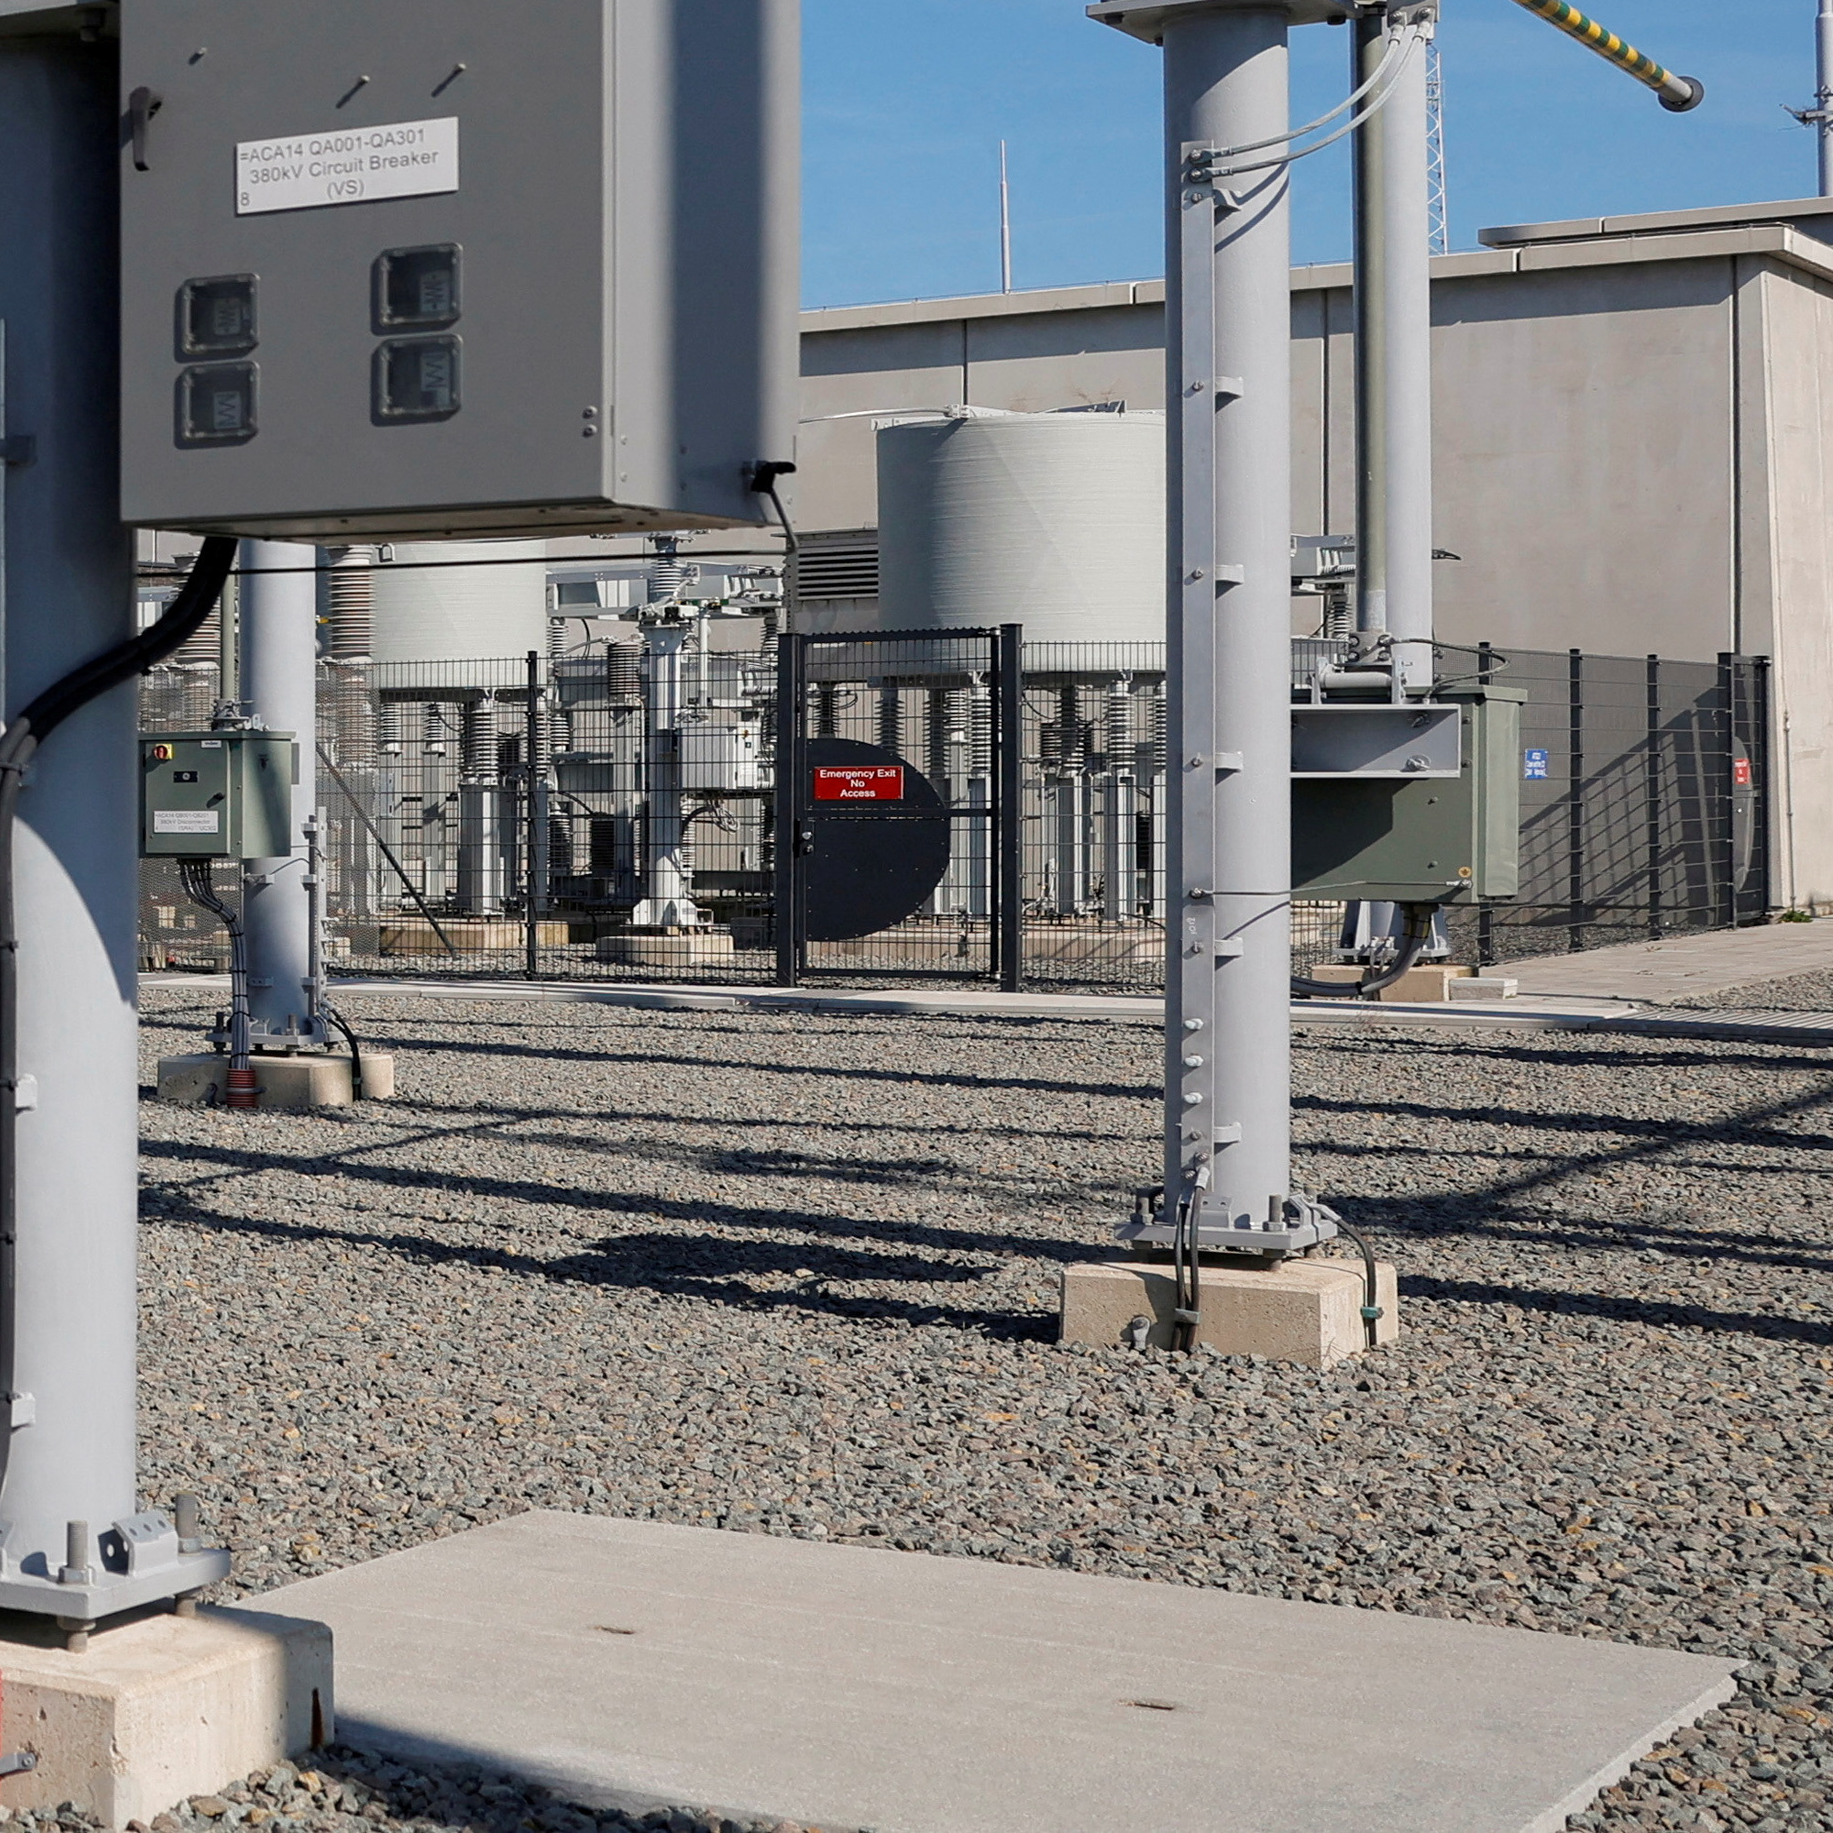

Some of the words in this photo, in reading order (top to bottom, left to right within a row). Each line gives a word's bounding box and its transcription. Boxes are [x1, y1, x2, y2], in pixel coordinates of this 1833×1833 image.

[240, 143, 303, 163] =ACA14
[309, 128, 424, 154] QA001-QA301
[250, 164, 304, 184] 380kV
[309, 158, 364, 177] Circuit
[370, 151, 438, 170] Breaker
[327, 179, 364, 199] (VS)
[240, 192, 250, 206] 8
[820, 770, 874, 780] Emergency
[877, 769, 896, 778] Exit
[850, 780, 866, 788] No
[840, 789, 876, 798] Access
